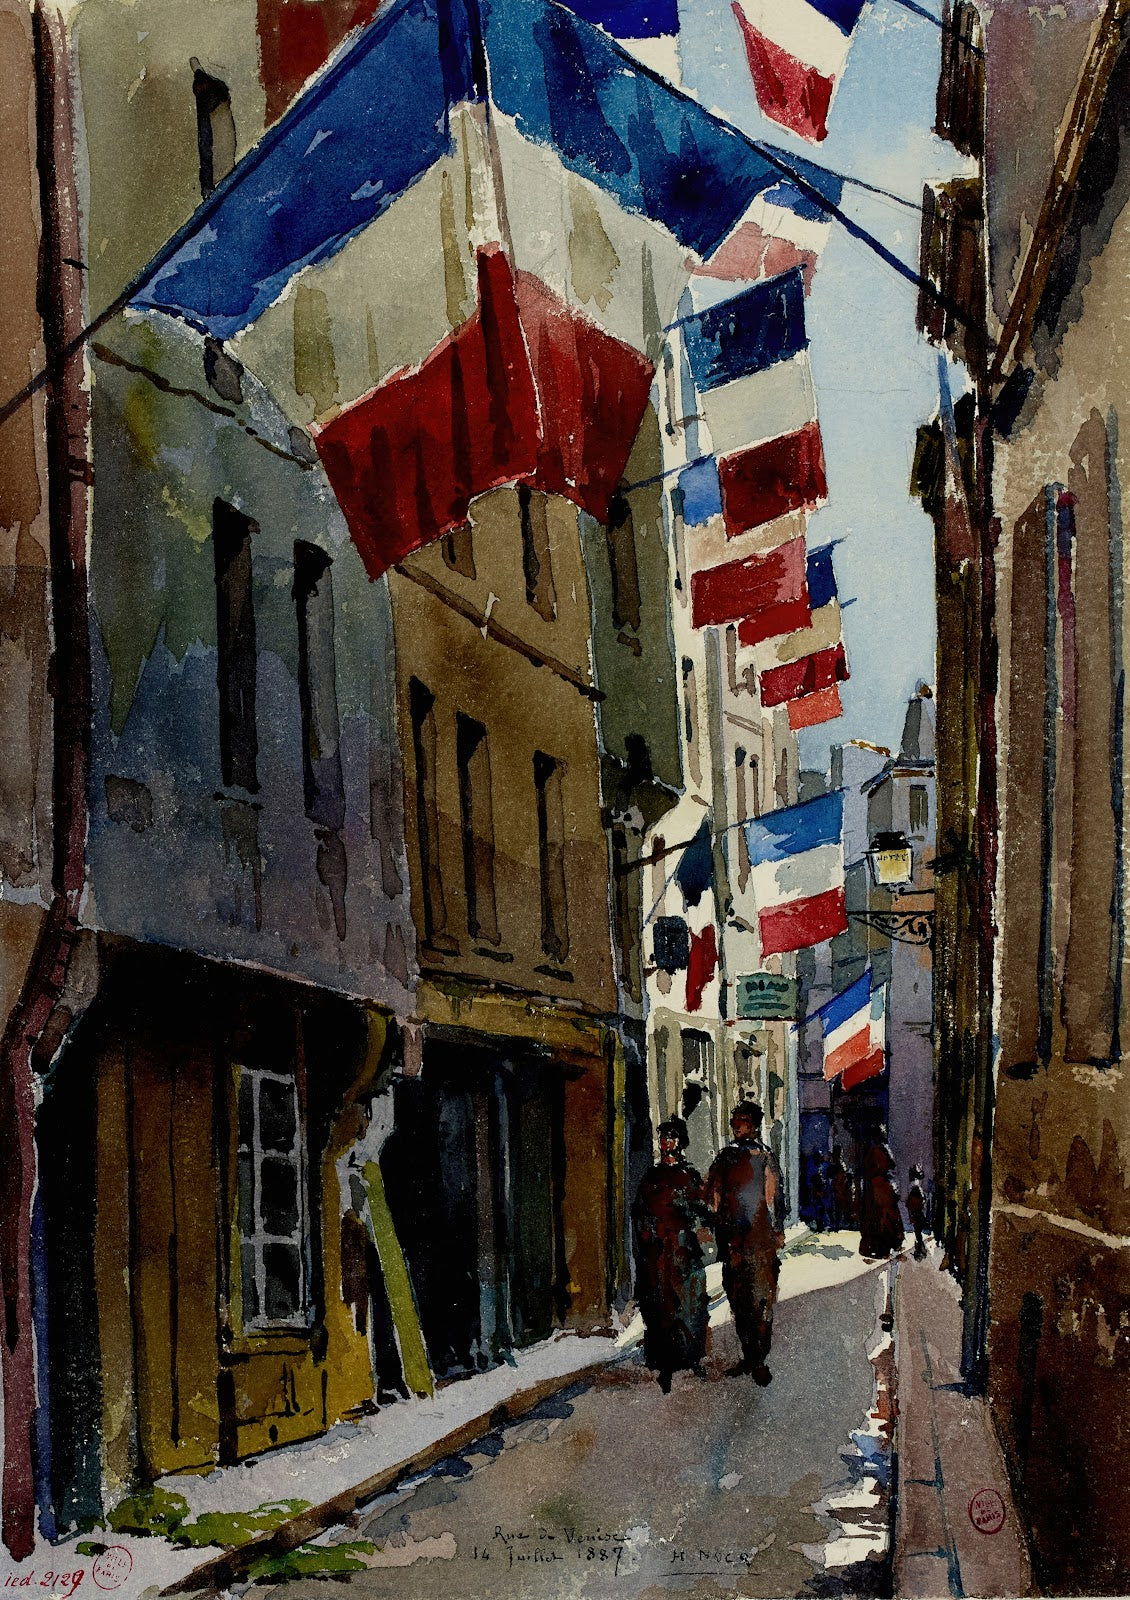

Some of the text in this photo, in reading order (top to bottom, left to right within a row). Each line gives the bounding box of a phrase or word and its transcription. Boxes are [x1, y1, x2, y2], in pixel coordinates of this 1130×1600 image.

[492, 1525, 530, 1544] Rue
[563, 1527, 632, 1544] Venise
[473, 1546, 490, 1560] 14
